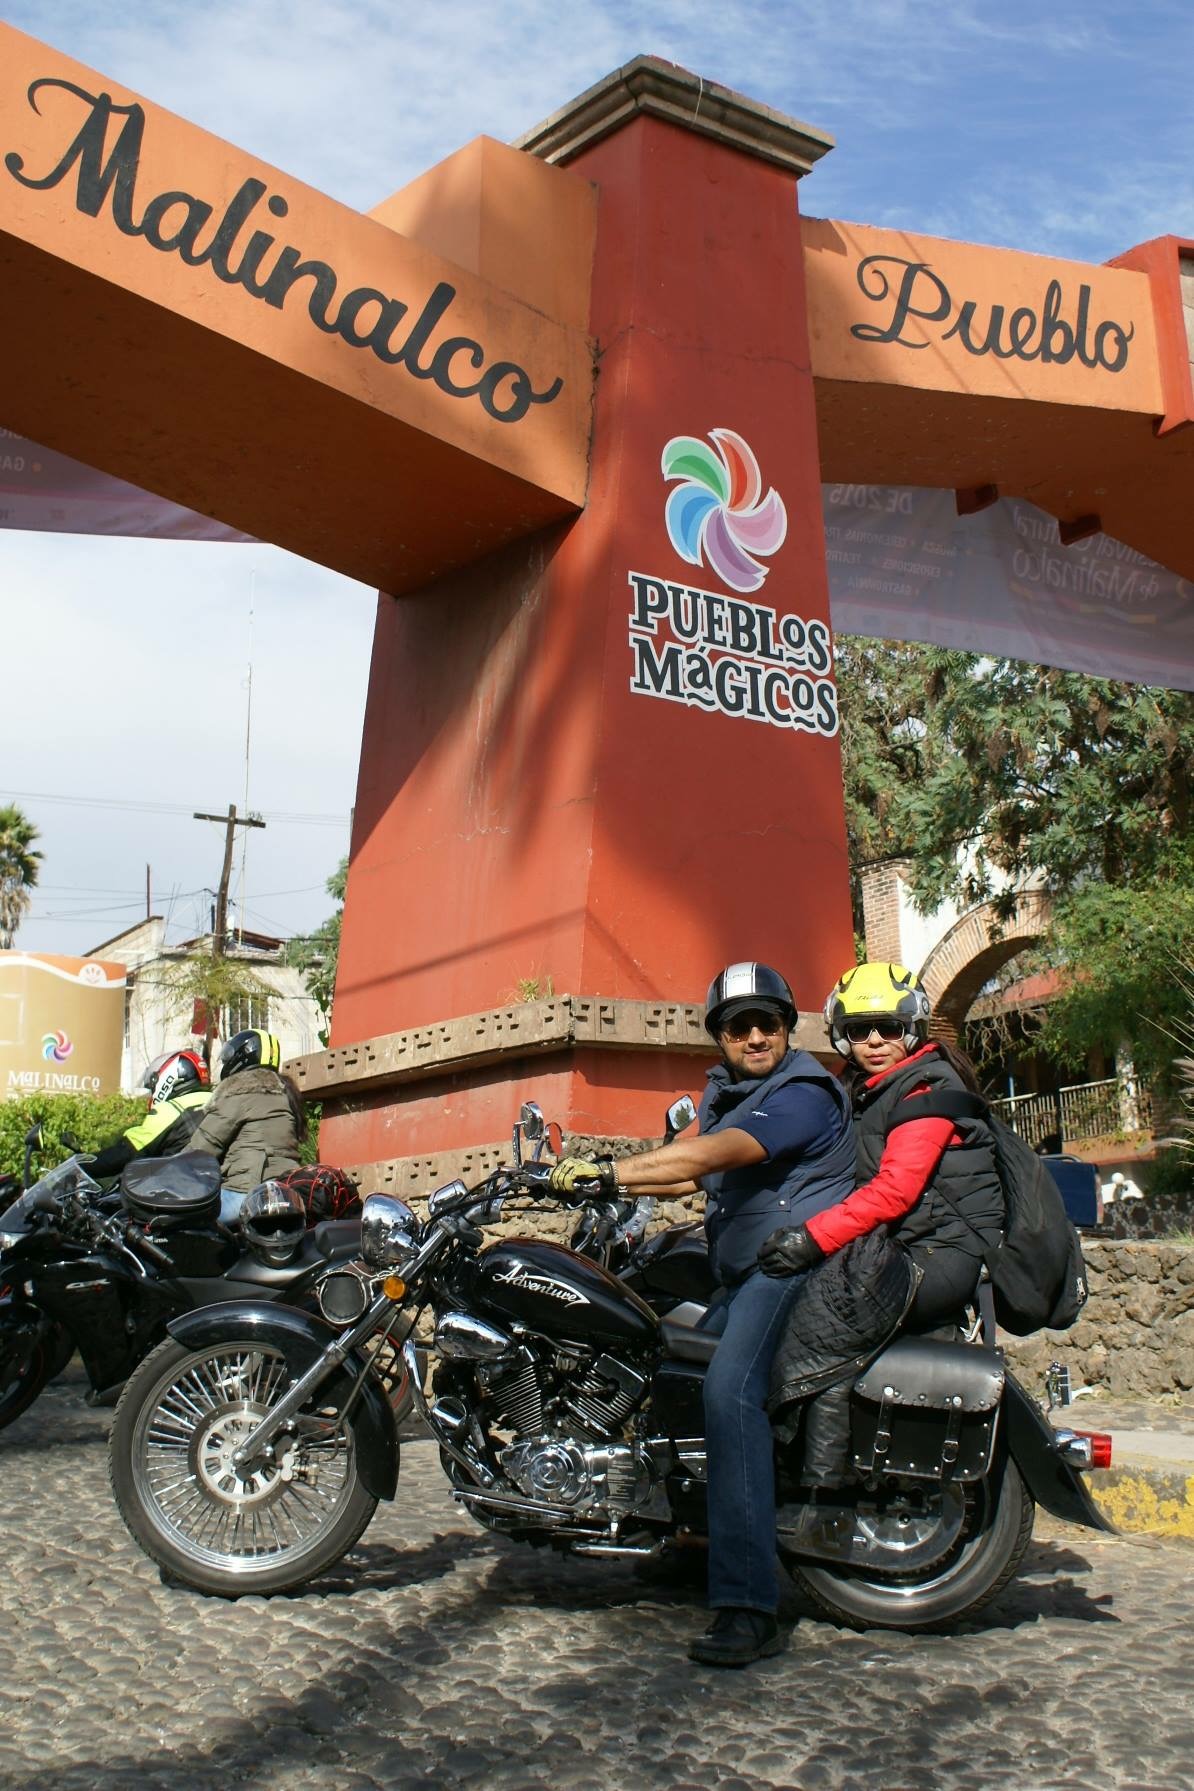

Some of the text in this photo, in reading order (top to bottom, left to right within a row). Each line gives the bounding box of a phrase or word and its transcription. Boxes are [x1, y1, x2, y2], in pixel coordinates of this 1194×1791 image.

[5, 78, 563, 423] Malinalco
[850, 255, 1134, 372] Pueblo
[630, 573, 829, 673] PUEBLOS
[492, 1263, 582, 1303] Adventure
